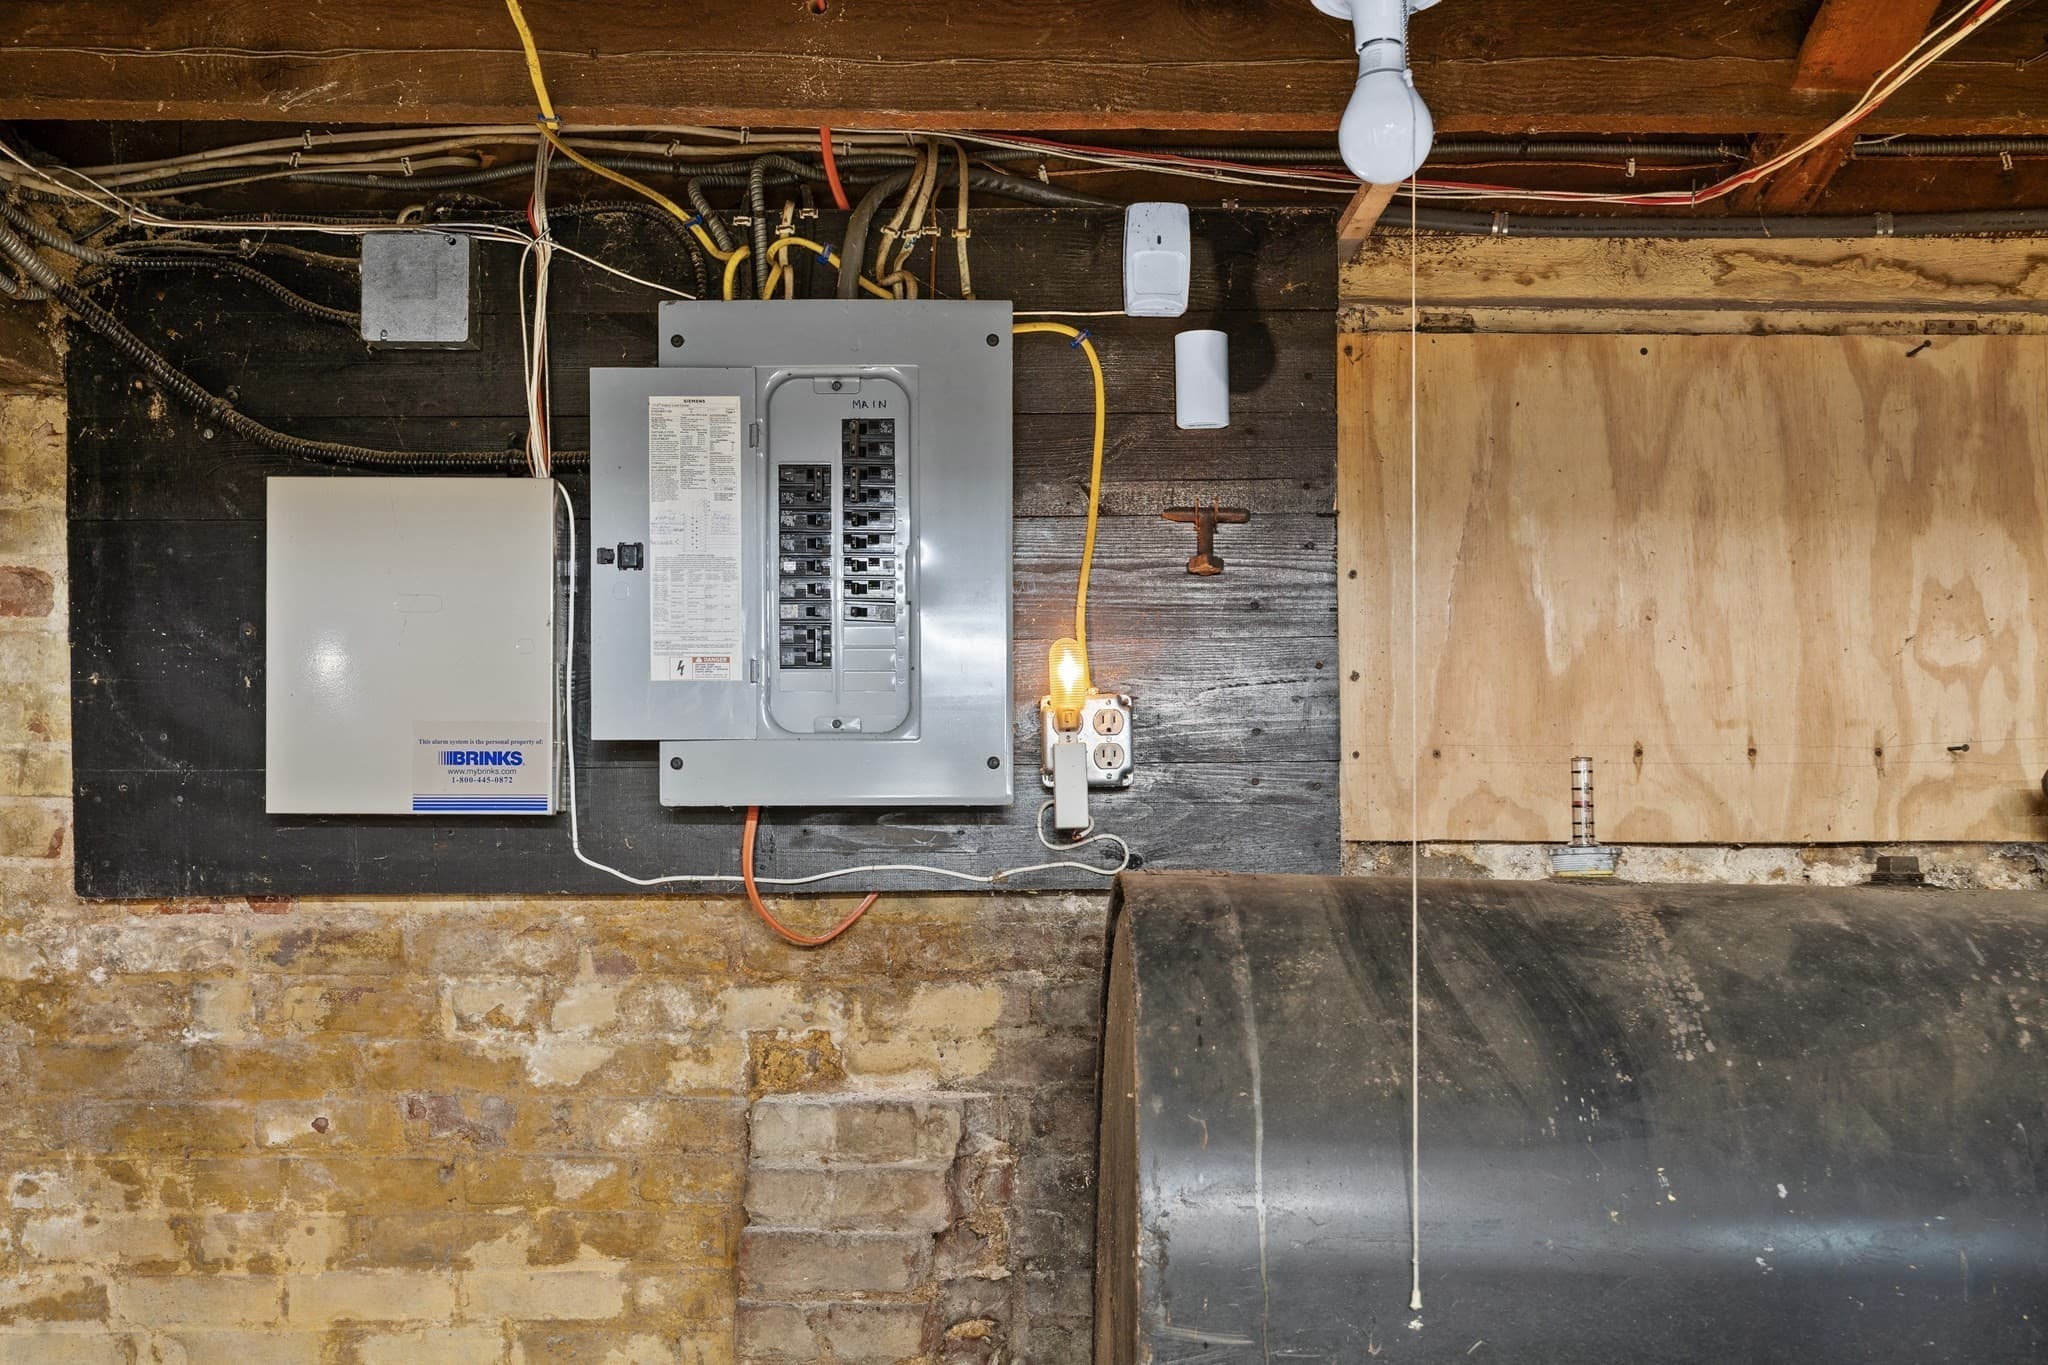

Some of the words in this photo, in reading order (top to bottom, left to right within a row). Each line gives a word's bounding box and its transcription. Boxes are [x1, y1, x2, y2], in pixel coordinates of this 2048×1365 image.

[852, 399, 887, 409] MAIN
[452, 751, 523, 765] BRINKS
[447, 768, 517, 776] www.mybrinks.com
